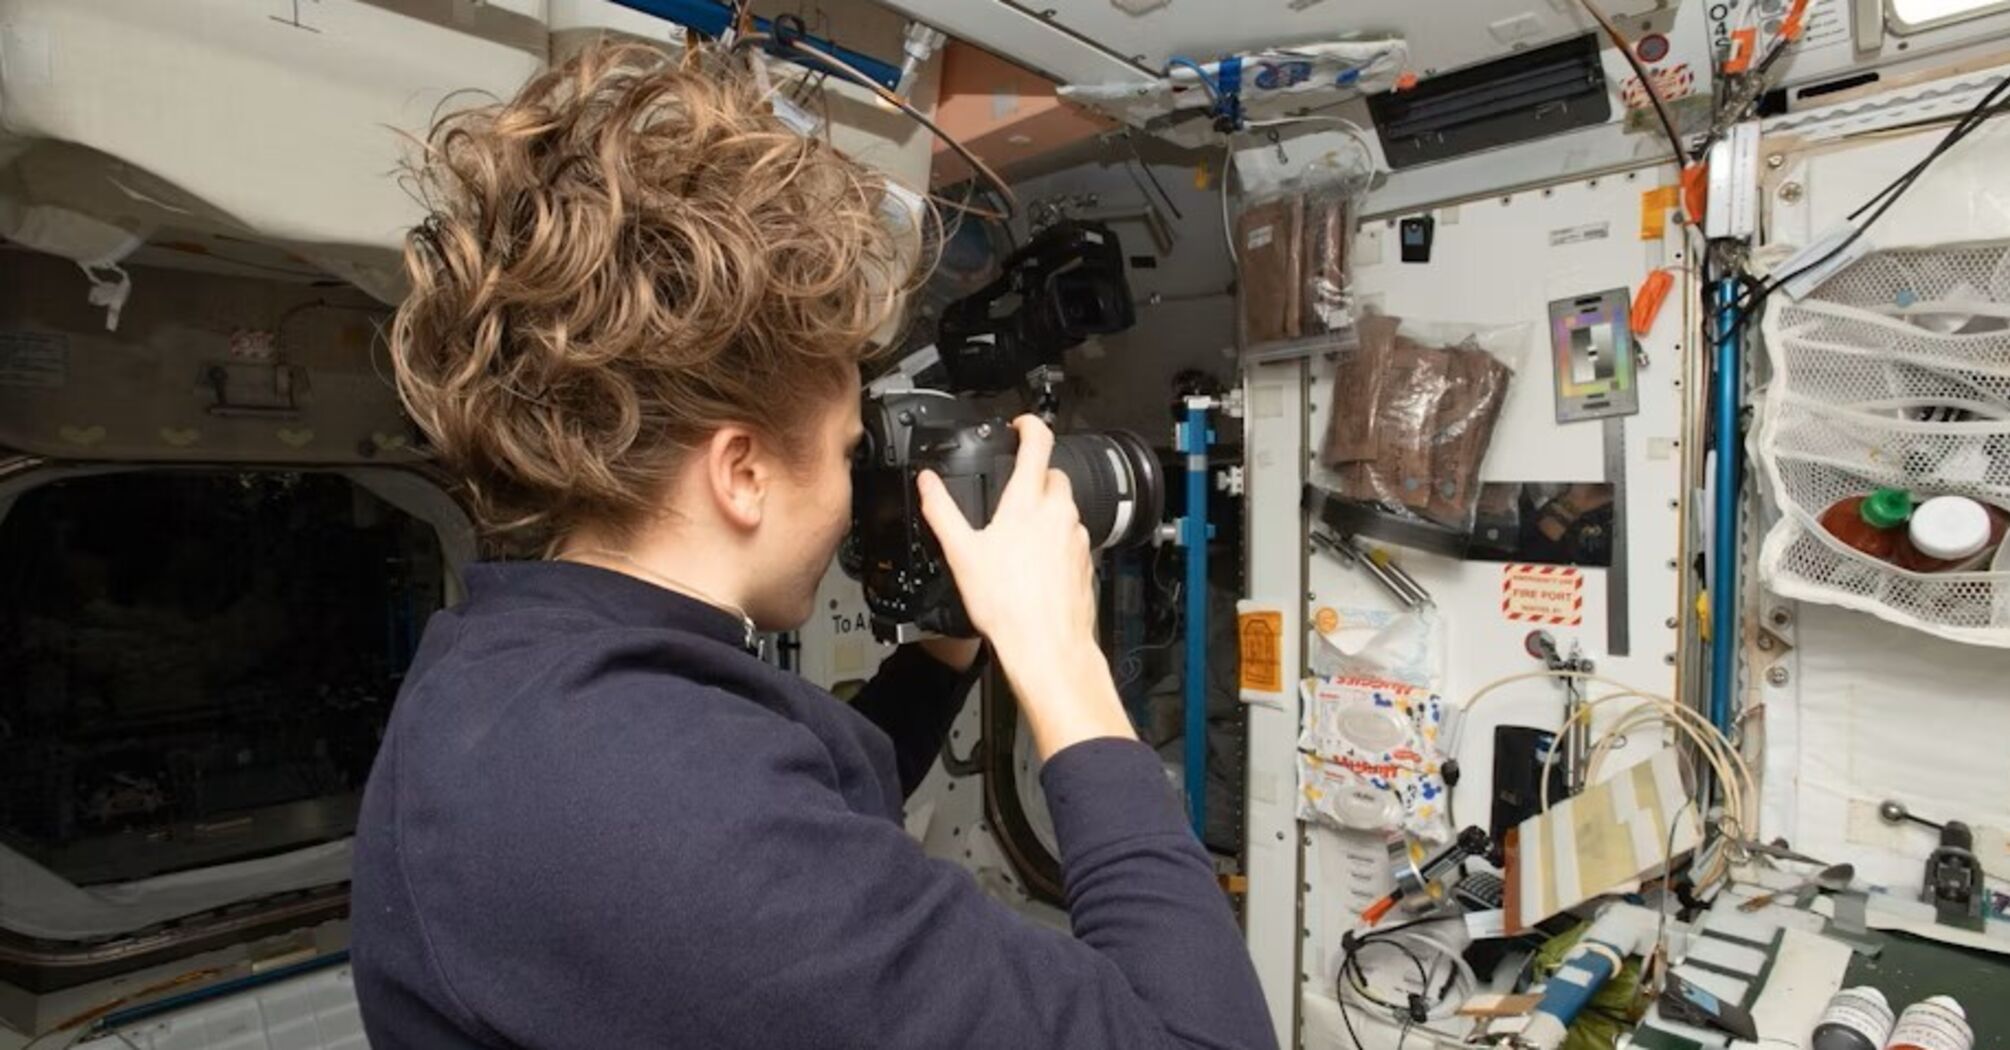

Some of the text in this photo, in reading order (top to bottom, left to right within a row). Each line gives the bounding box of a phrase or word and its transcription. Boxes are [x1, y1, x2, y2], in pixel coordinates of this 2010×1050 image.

[1513, 589, 1572, 601] FIRE PORT
[832, 612, 871, 635] To A
